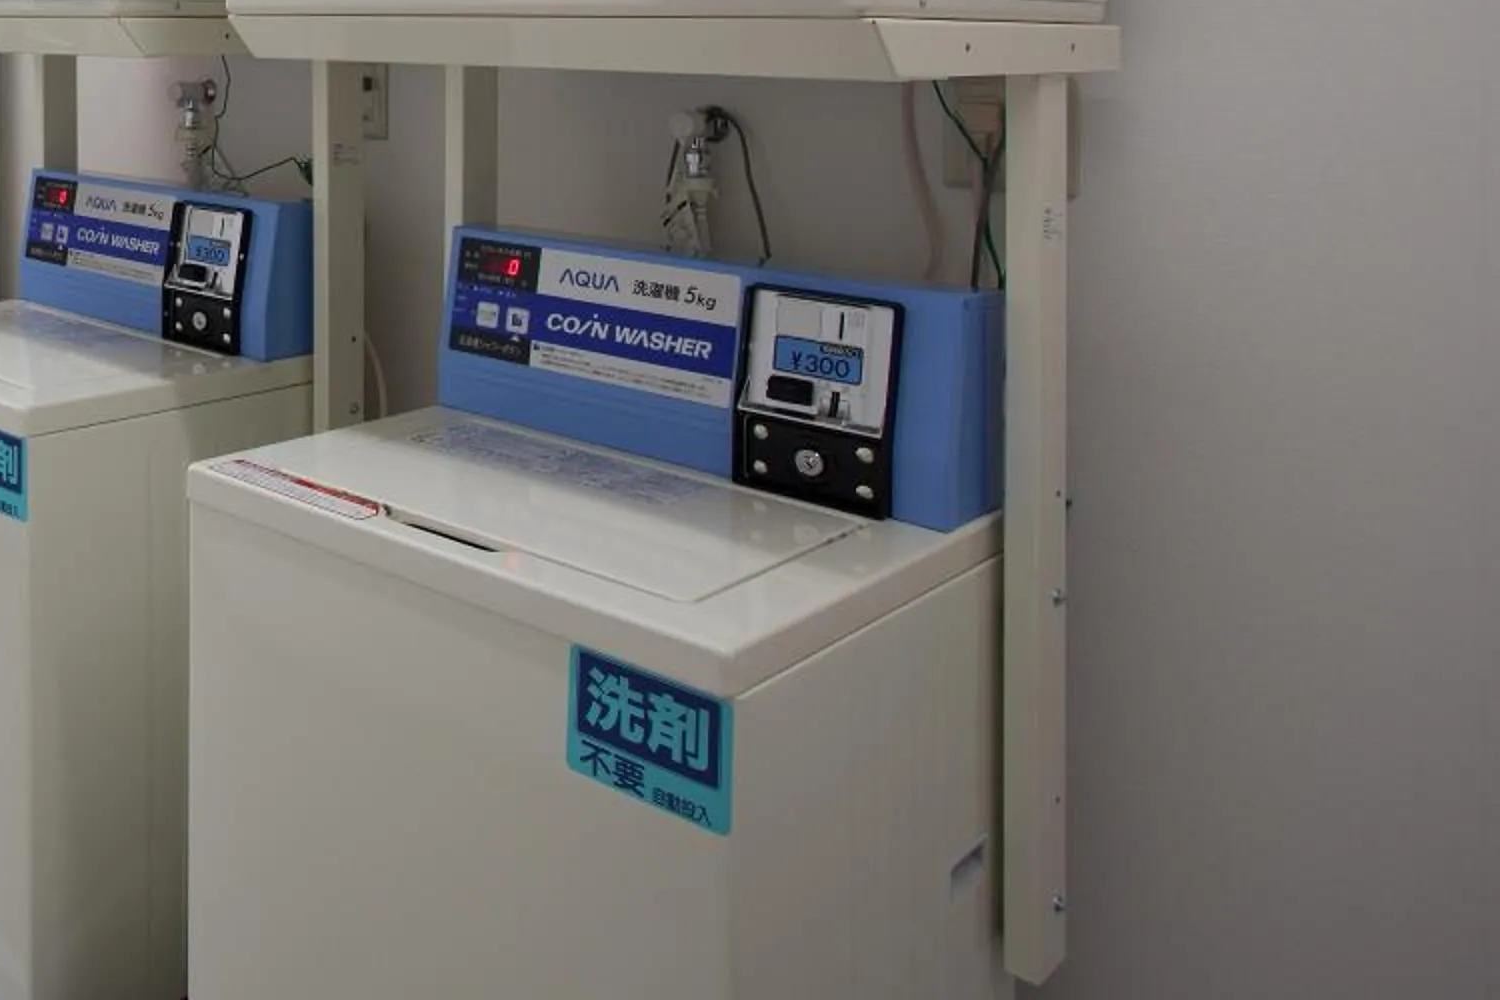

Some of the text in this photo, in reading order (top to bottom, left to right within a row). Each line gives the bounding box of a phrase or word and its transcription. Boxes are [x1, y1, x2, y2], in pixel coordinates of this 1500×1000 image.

[110, 232, 161, 256] WASHER
[507, 257, 520, 276] 0
[559, 268, 718, 312] AQUA 洗濯機 5kg
[614, 323, 713, 360] WASHER
[791, 350, 852, 379] ¥300
[585, 665, 710, 772] 洗剤
[579, 739, 713, 828] 不要 自動投入
